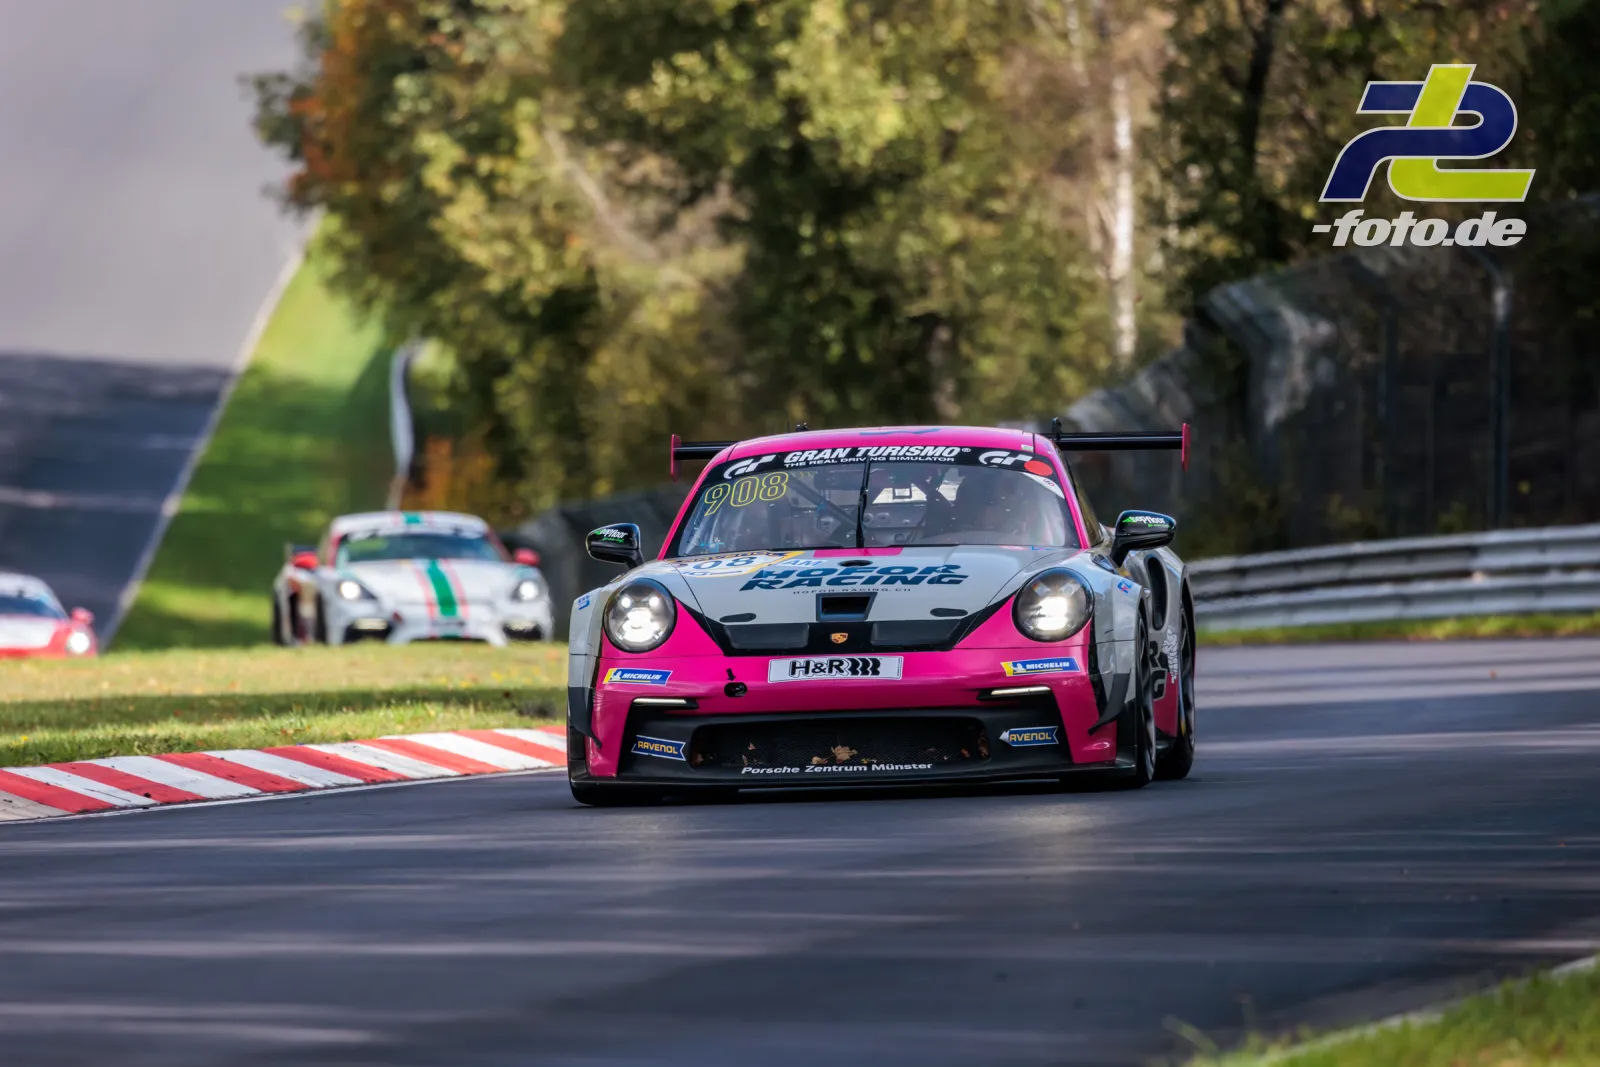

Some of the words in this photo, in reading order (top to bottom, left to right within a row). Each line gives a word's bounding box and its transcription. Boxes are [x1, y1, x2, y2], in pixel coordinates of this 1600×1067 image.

[783, 447, 852, 464] GRAN
[704, 471, 789, 517] 908
[751, 564, 962, 580] HOFOR
[739, 574, 969, 592] RACING
[789, 657, 849, 678] H&R
[1025, 661, 1070, 670] MICHELIN
[620, 672, 662, 681] MICHELIN
[1008, 732, 1052, 742] AVENOL
[637, 740, 679, 755] RAVENOL
[741, 766, 800, 774] Porsche
[805, 763, 868, 773] Zentrum
[871, 762, 932, 771] Münster
